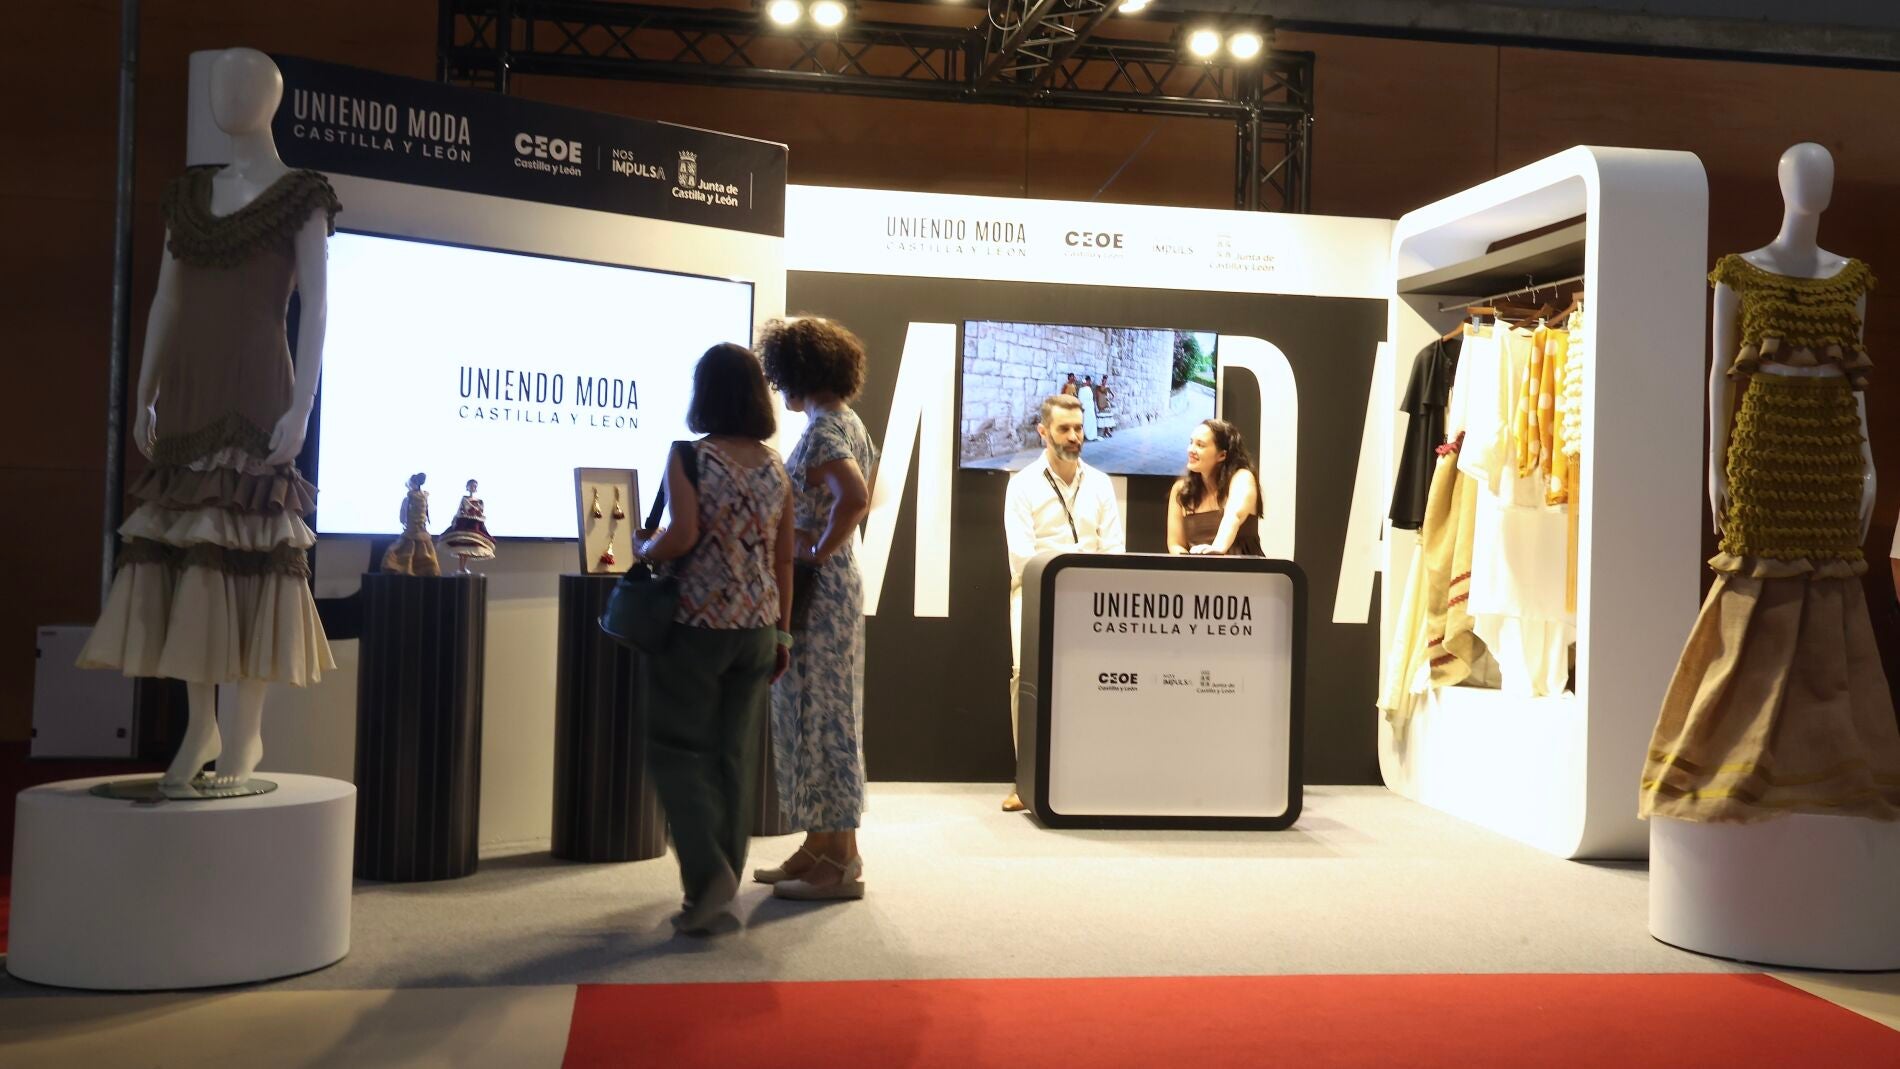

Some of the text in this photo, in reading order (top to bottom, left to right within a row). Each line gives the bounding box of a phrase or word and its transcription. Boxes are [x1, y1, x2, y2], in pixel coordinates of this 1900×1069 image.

[293, 88, 471, 146] UNIENDO MODA
[293, 124, 471, 163] CASTILLA Y LEÓN
[514, 132, 582, 164] CEOE
[612, 148, 634, 161] NOS
[514, 157, 582, 177] Castilla y León
[612, 159, 666, 181] IMPULSA
[671, 186, 738, 207] Castilla y León
[697, 179, 739, 195] Junta de
[887, 216, 1026, 244] UNIENDO MODA
[1065, 231, 1123, 249] CEOE
[459, 366, 638, 410] UNIENDO MODA
[458, 405, 560, 424] CASTILLA
[570, 412, 579, 425] Y
[1093, 592, 1252, 621] UNIENDO MODA
[1093, 621, 1252, 636] CASTILLA Y LEÓN
[1098, 672, 1138, 685] CEOE
